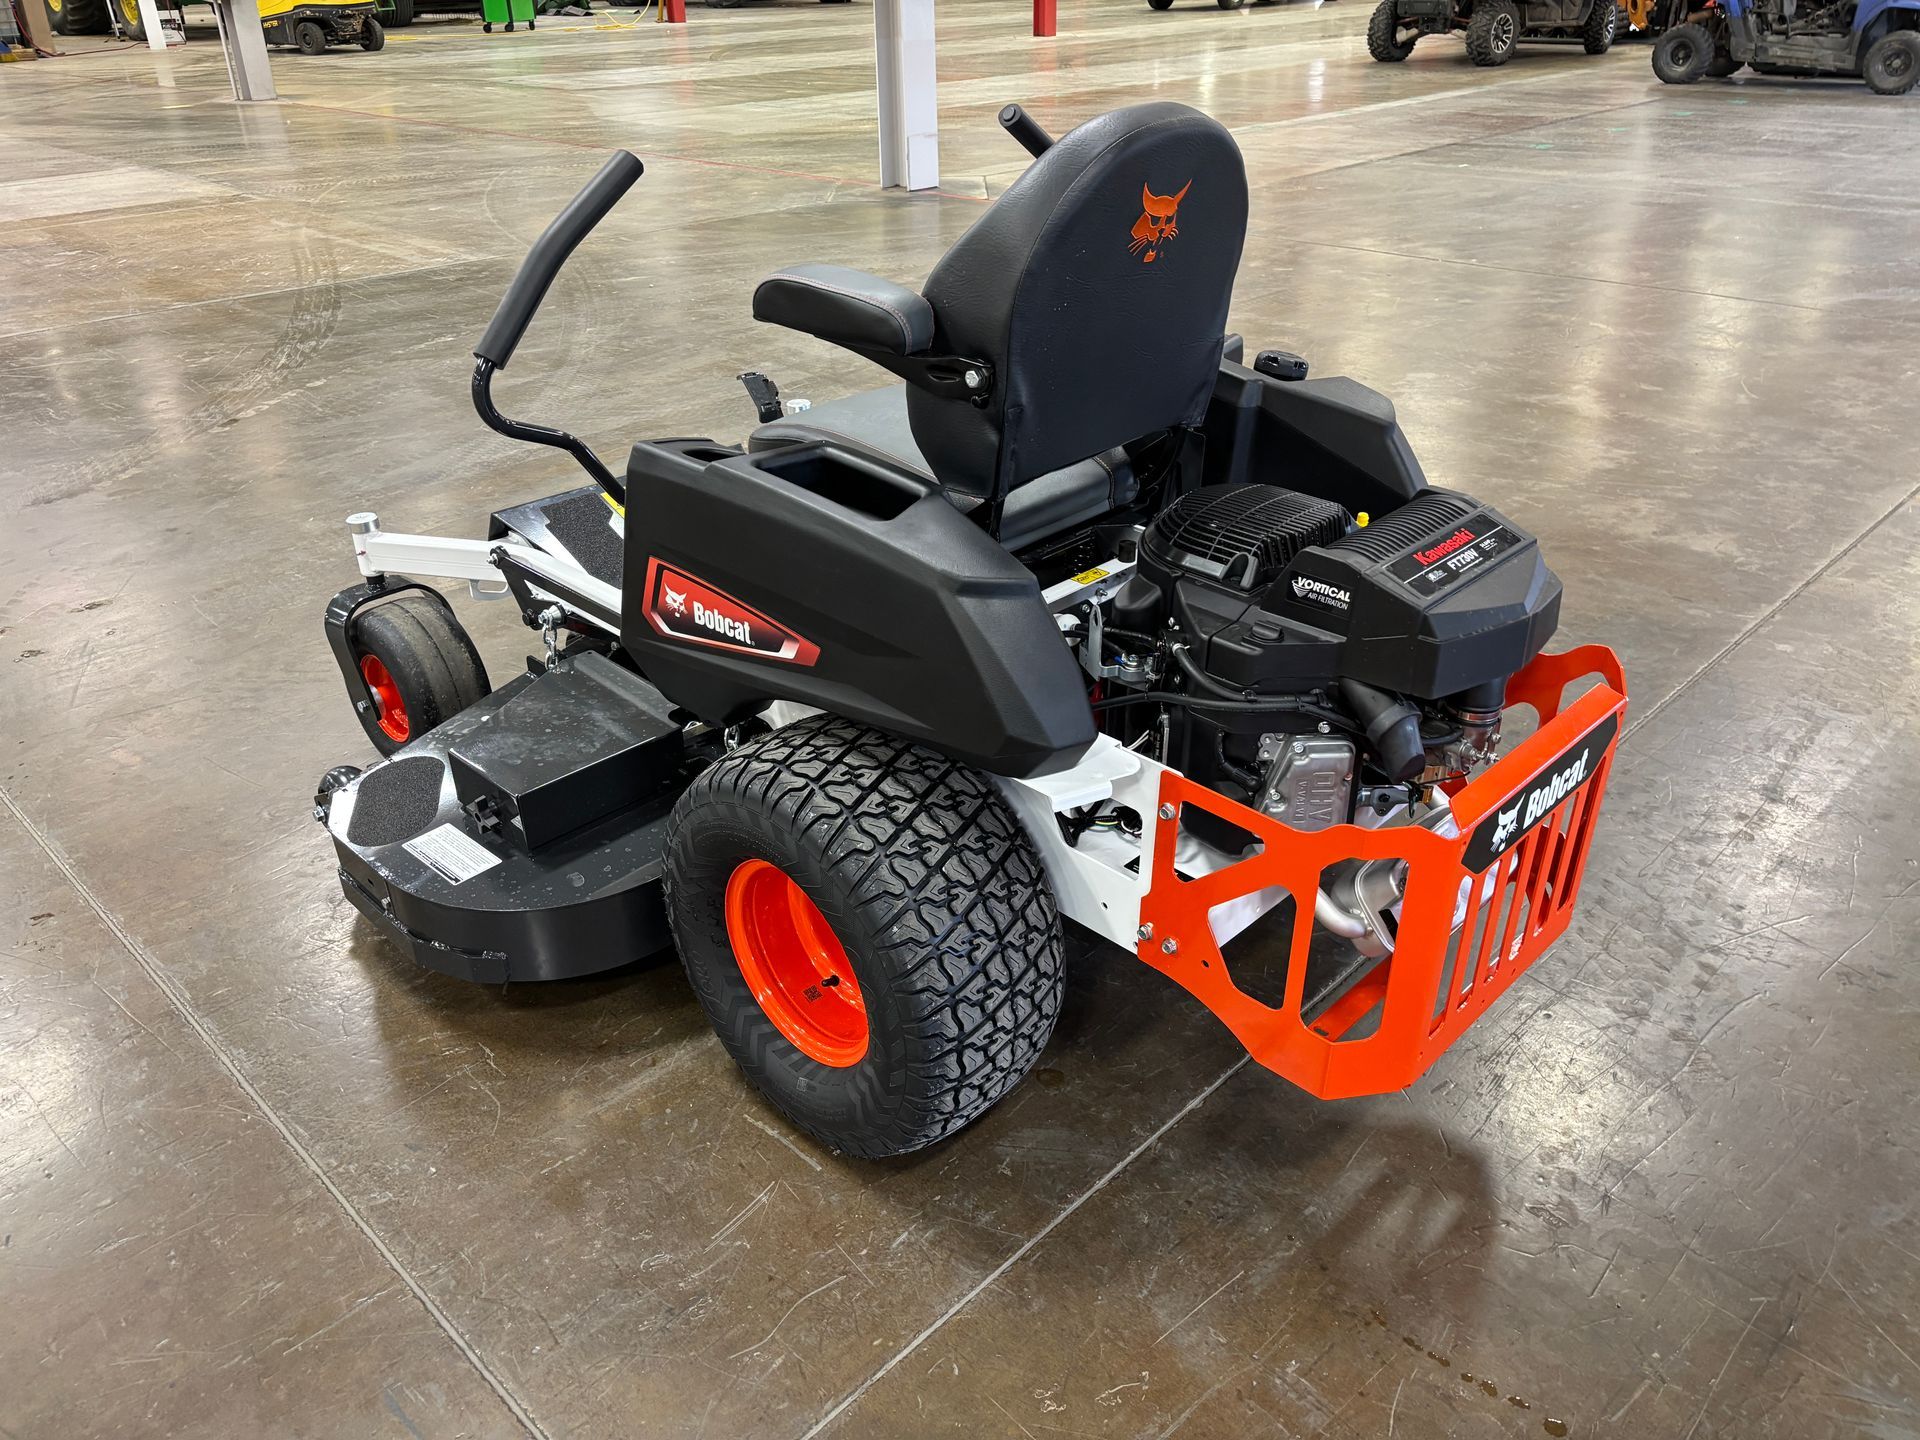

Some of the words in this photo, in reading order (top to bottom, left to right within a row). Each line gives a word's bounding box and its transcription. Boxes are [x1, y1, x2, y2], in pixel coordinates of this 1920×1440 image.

[1412, 528, 1476, 566] Kawasaki
[1446, 548, 1479, 570] FT730V
[1298, 576, 1350, 602] VORTICAL
[1307, 592, 1318, 601] AIR
[1317, 594, 1349, 611] FILTRATION
[692, 600, 753, 646] Bobcat
[1523, 748, 1589, 830] Bobcat
